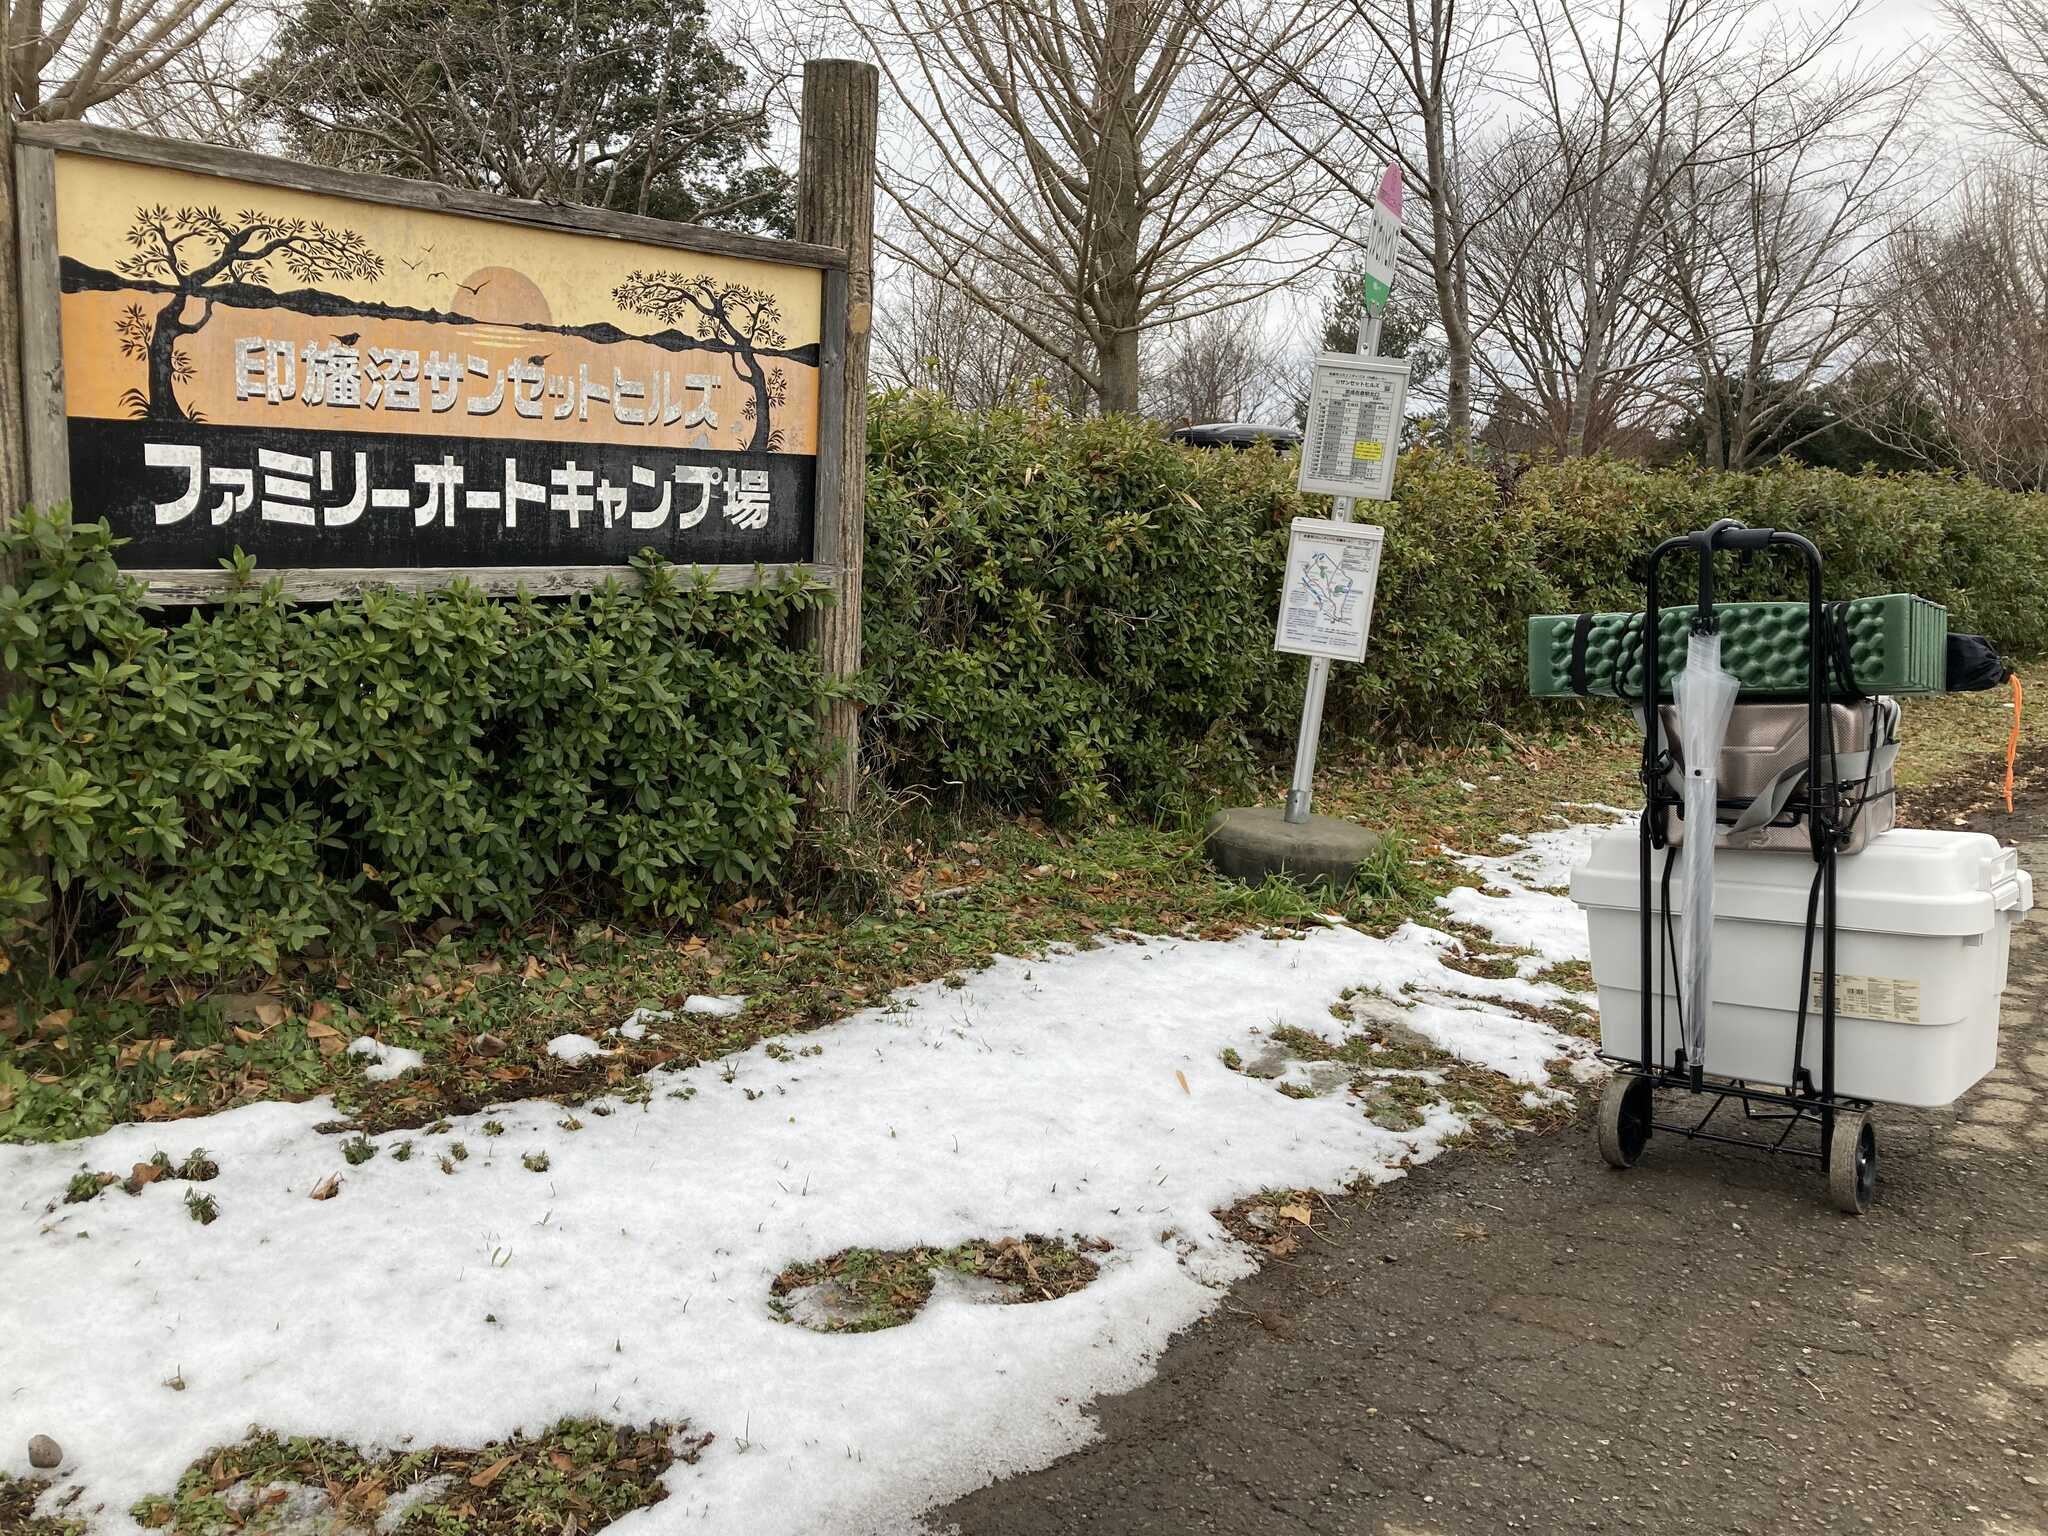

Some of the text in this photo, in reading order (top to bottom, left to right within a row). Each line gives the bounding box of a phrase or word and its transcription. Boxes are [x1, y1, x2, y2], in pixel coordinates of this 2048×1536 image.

[235, 335, 720, 430] 印旛沼サンセットヒルズ
[144, 443, 771, 530] ファミリーオートキャンプ場
